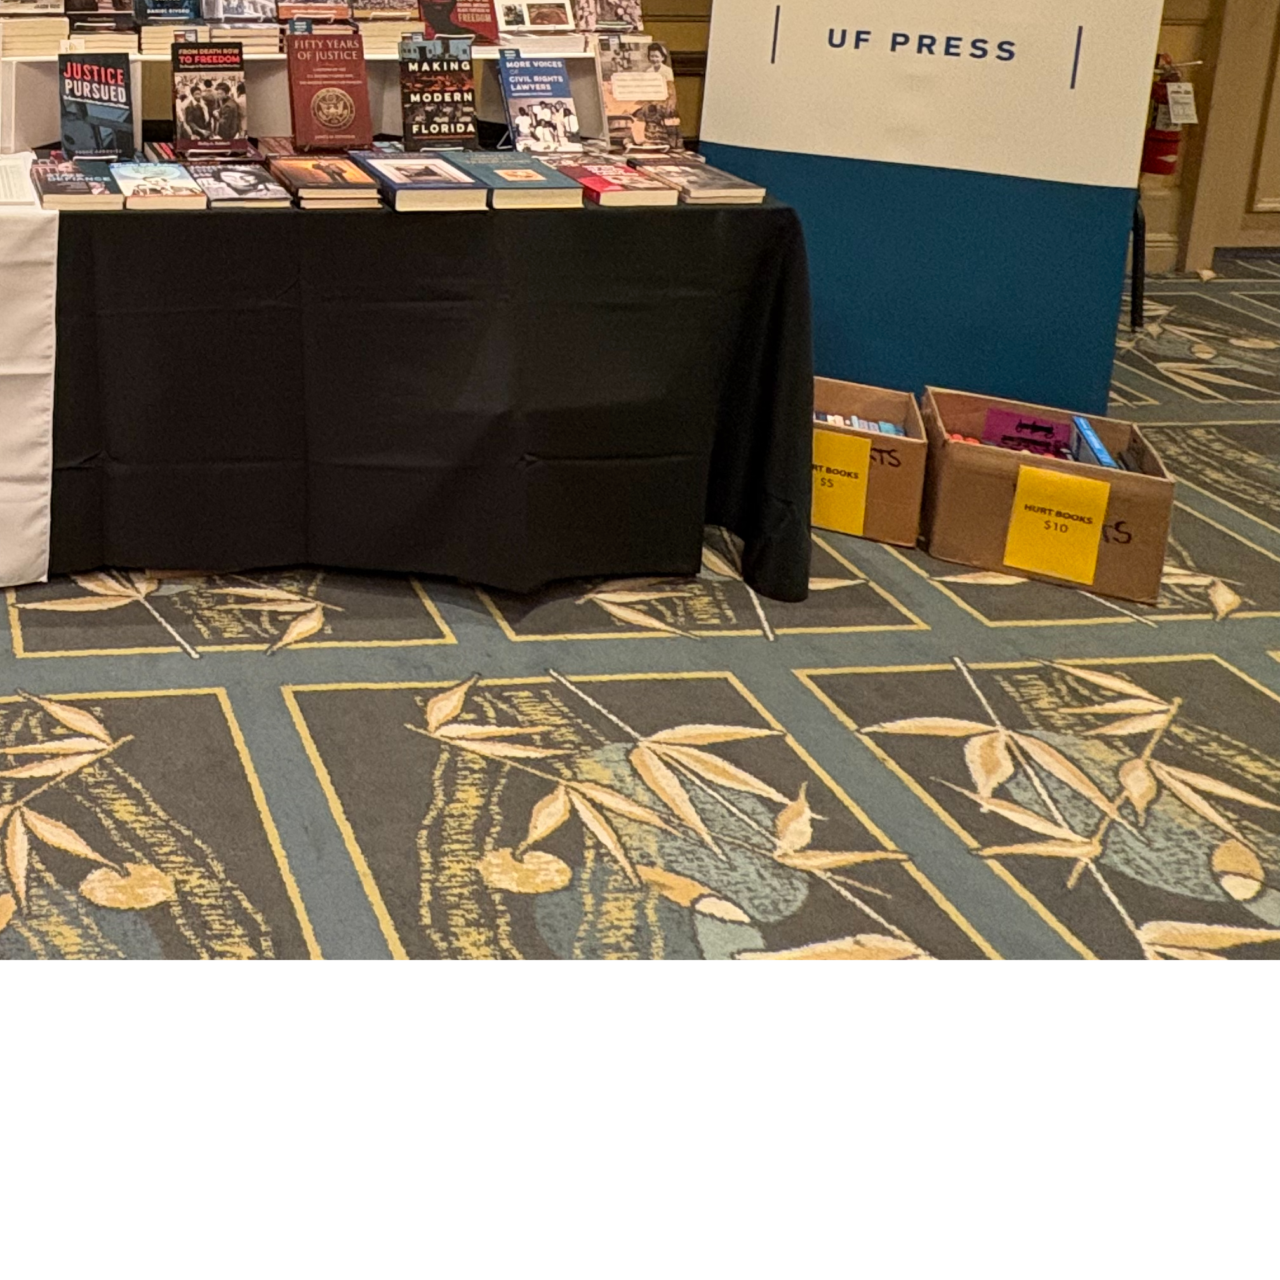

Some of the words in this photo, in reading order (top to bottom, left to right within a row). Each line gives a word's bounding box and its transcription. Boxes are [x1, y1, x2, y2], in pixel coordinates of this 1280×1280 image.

[458, 13, 491, 22] FREEDOM
[294, 40, 324, 49] FIFTY
[326, 40, 359, 48] YEARS
[827, 28, 871, 50] UF
[889, 32, 1017, 61] PRESS
[195, 55, 240, 63] FREEDOM
[297, 51, 312, 60] OF
[316, 51, 358, 61] JUSTICE
[408, 62, 470, 72] MAKING
[63, 62, 124, 85] JUSTICE
[65, 79, 126, 102] PURSUED
[411, 93, 473, 102] MODERN
[412, 123, 475, 134] FLORIDA
[826, 467, 859, 479] BOOKS
[820, 477, 834, 487] $5
[1024, 504, 1054, 516] HURT
[1055, 511, 1093, 524] BOOKS
[1044, 520, 1069, 533] $10
